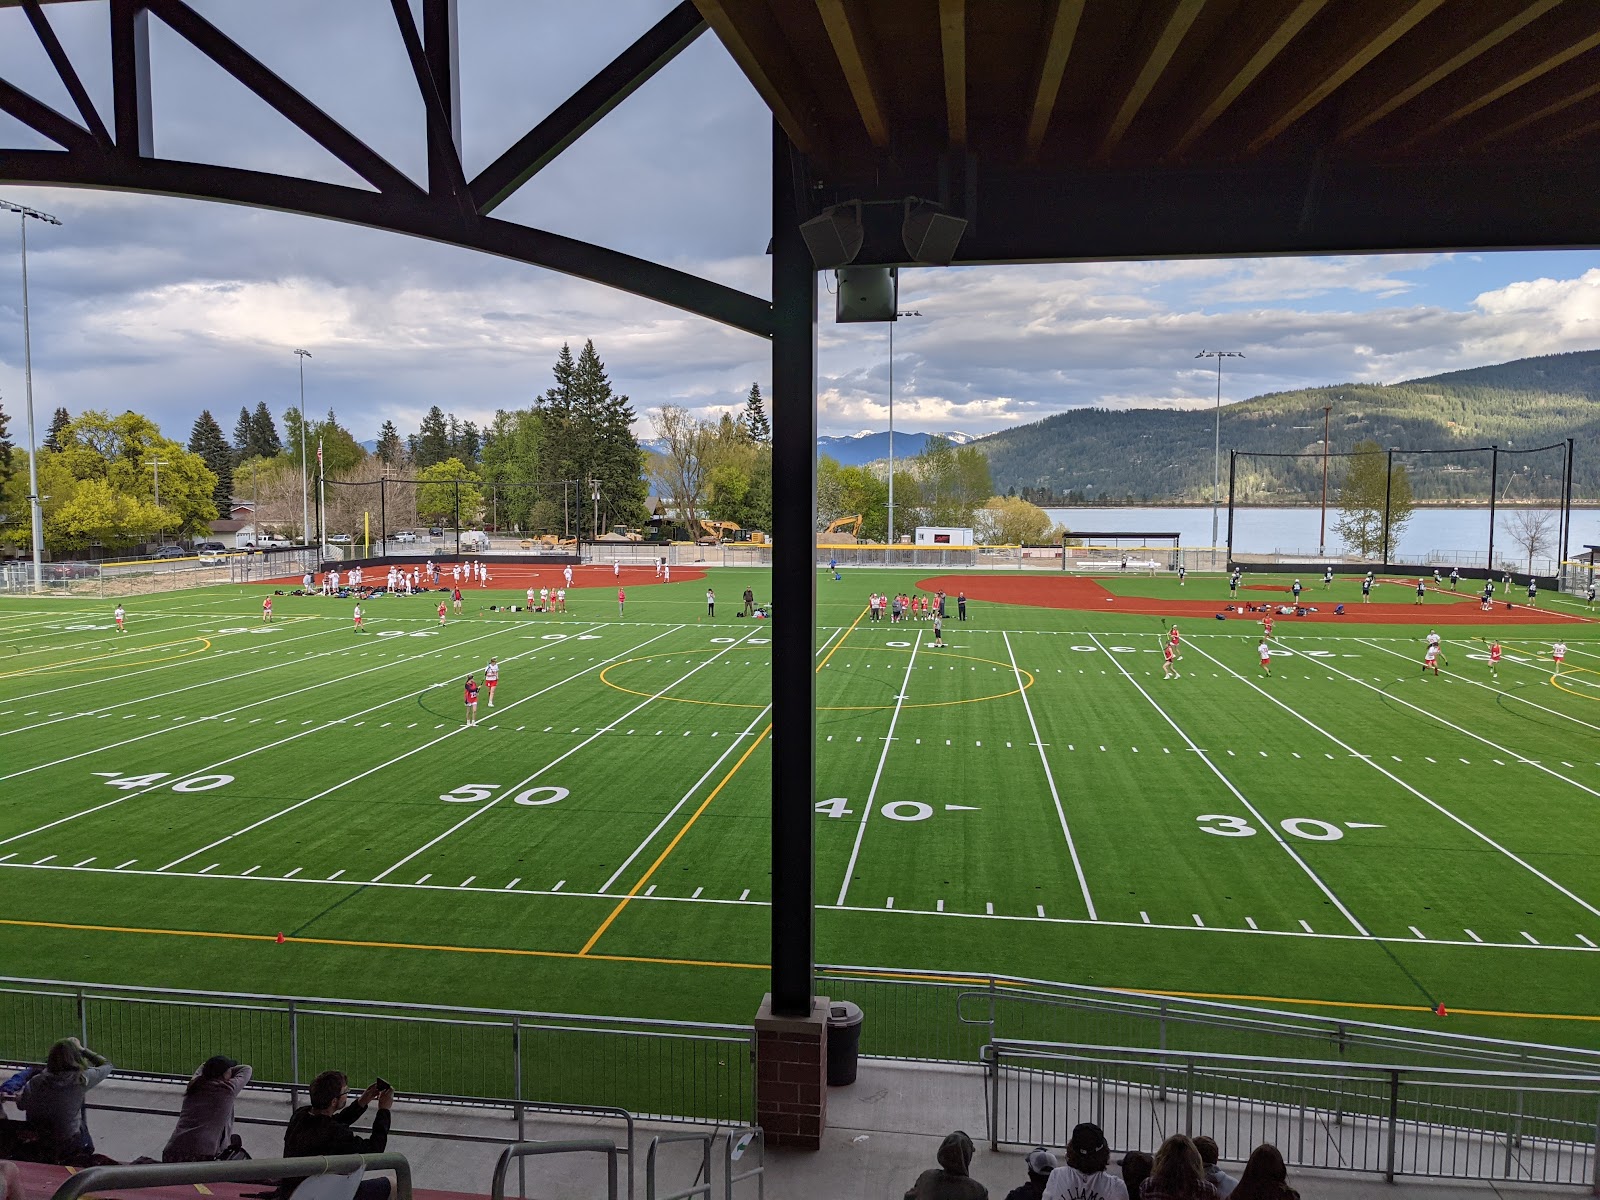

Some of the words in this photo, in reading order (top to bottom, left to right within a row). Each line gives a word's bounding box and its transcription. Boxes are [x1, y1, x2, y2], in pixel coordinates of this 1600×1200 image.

[104, 772, 235, 792] 40
[438, 783, 570, 806] 50
[815, 797, 933, 821] 40
[1196, 814, 1344, 841] 30
